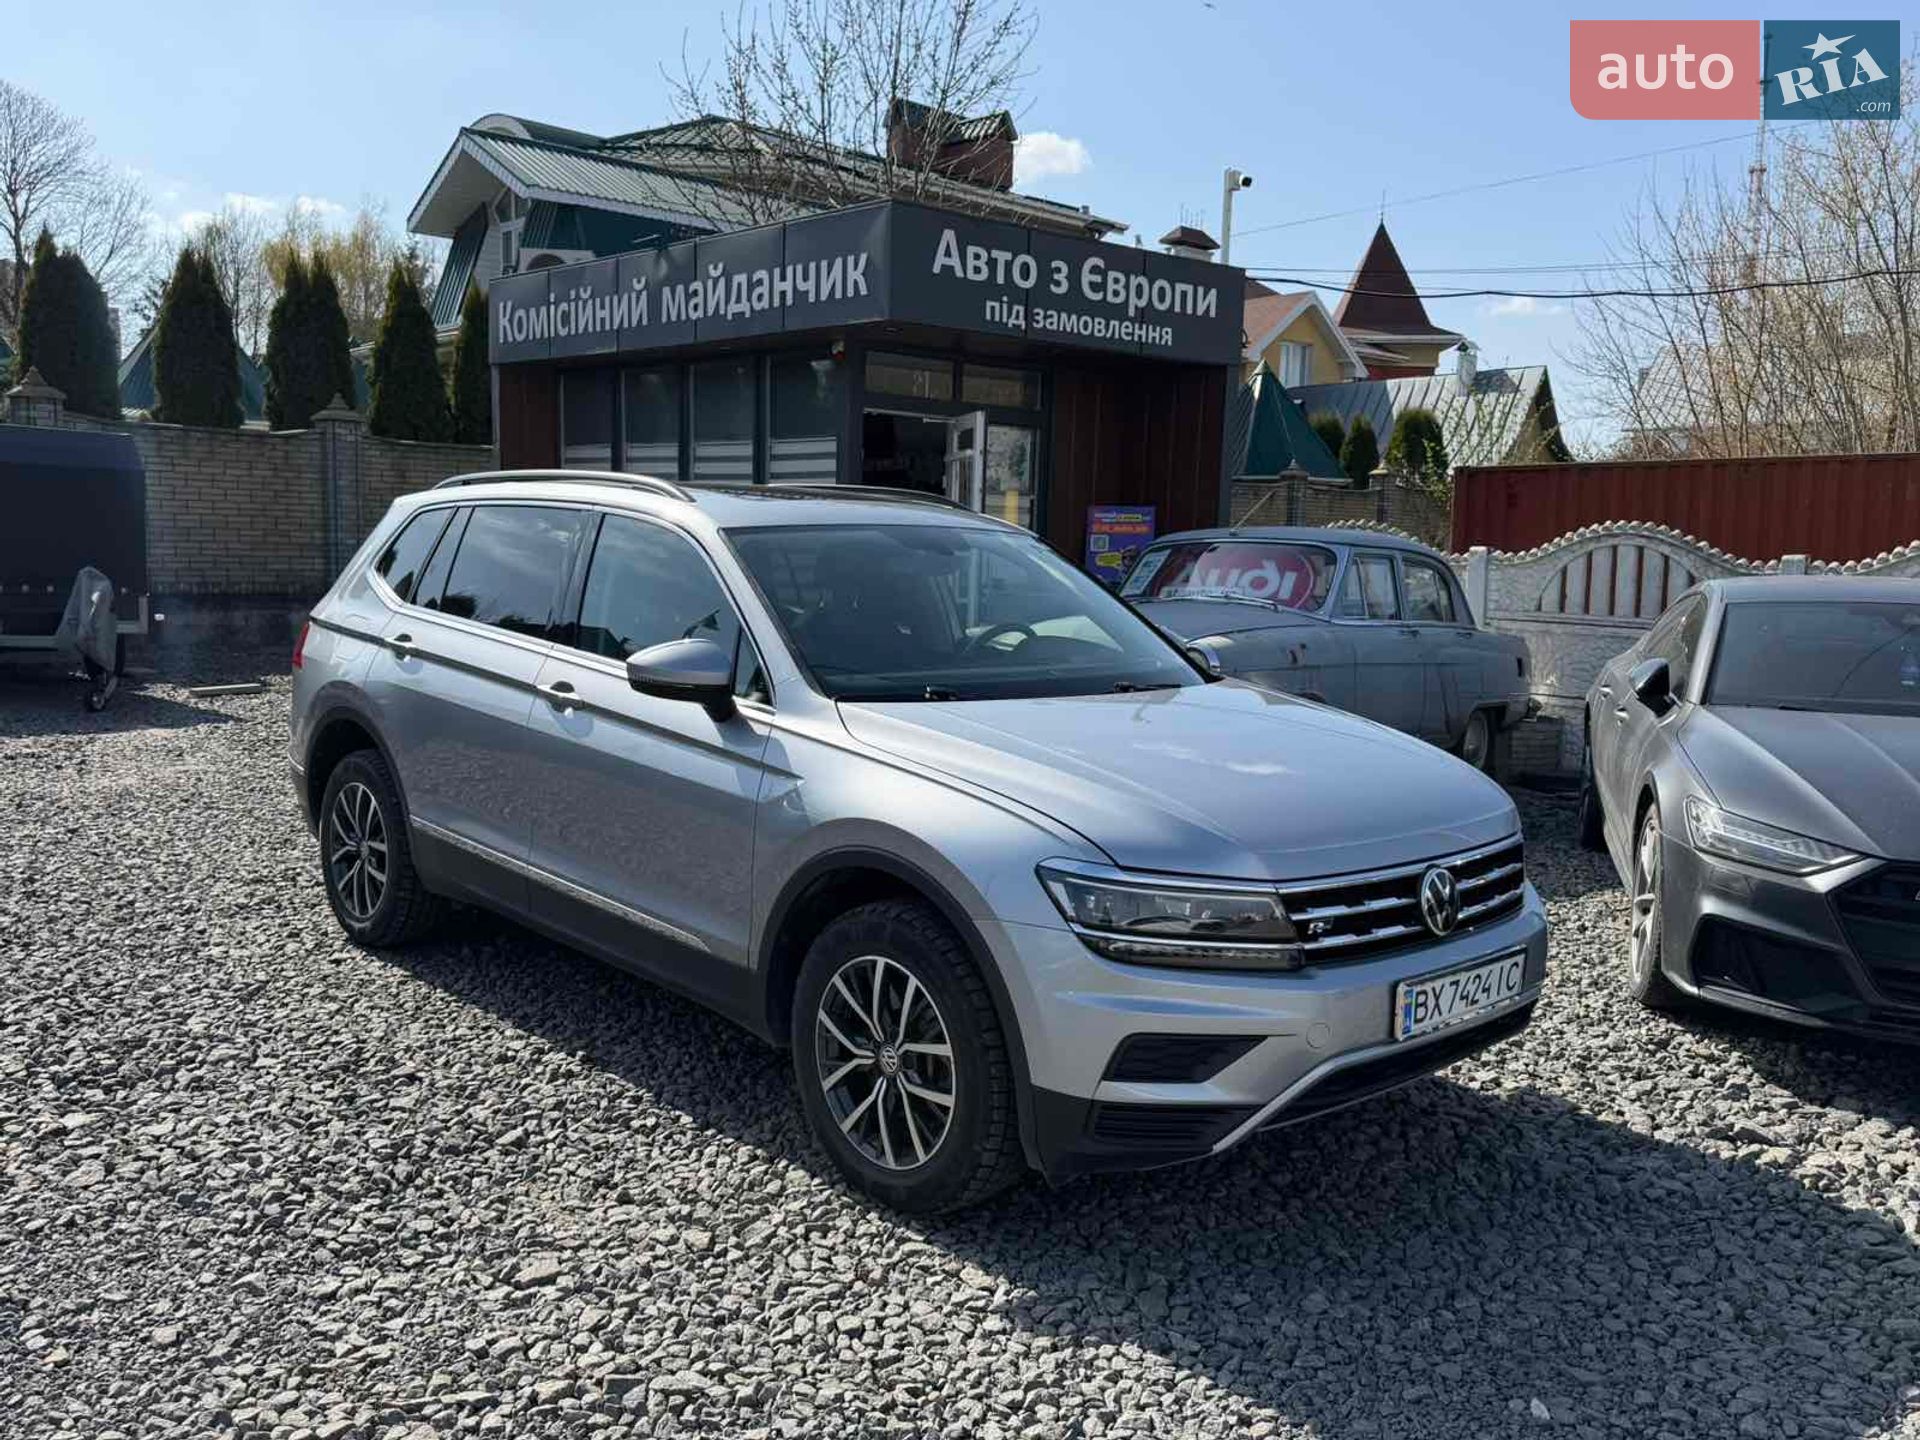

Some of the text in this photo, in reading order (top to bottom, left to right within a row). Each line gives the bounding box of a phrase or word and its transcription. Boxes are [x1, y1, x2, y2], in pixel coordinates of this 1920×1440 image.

[498, 252, 869, 344] Комісійний майданчик
[932, 228, 1218, 318] Авто з Європи
[985, 295, 1173, 346] під замовлення
